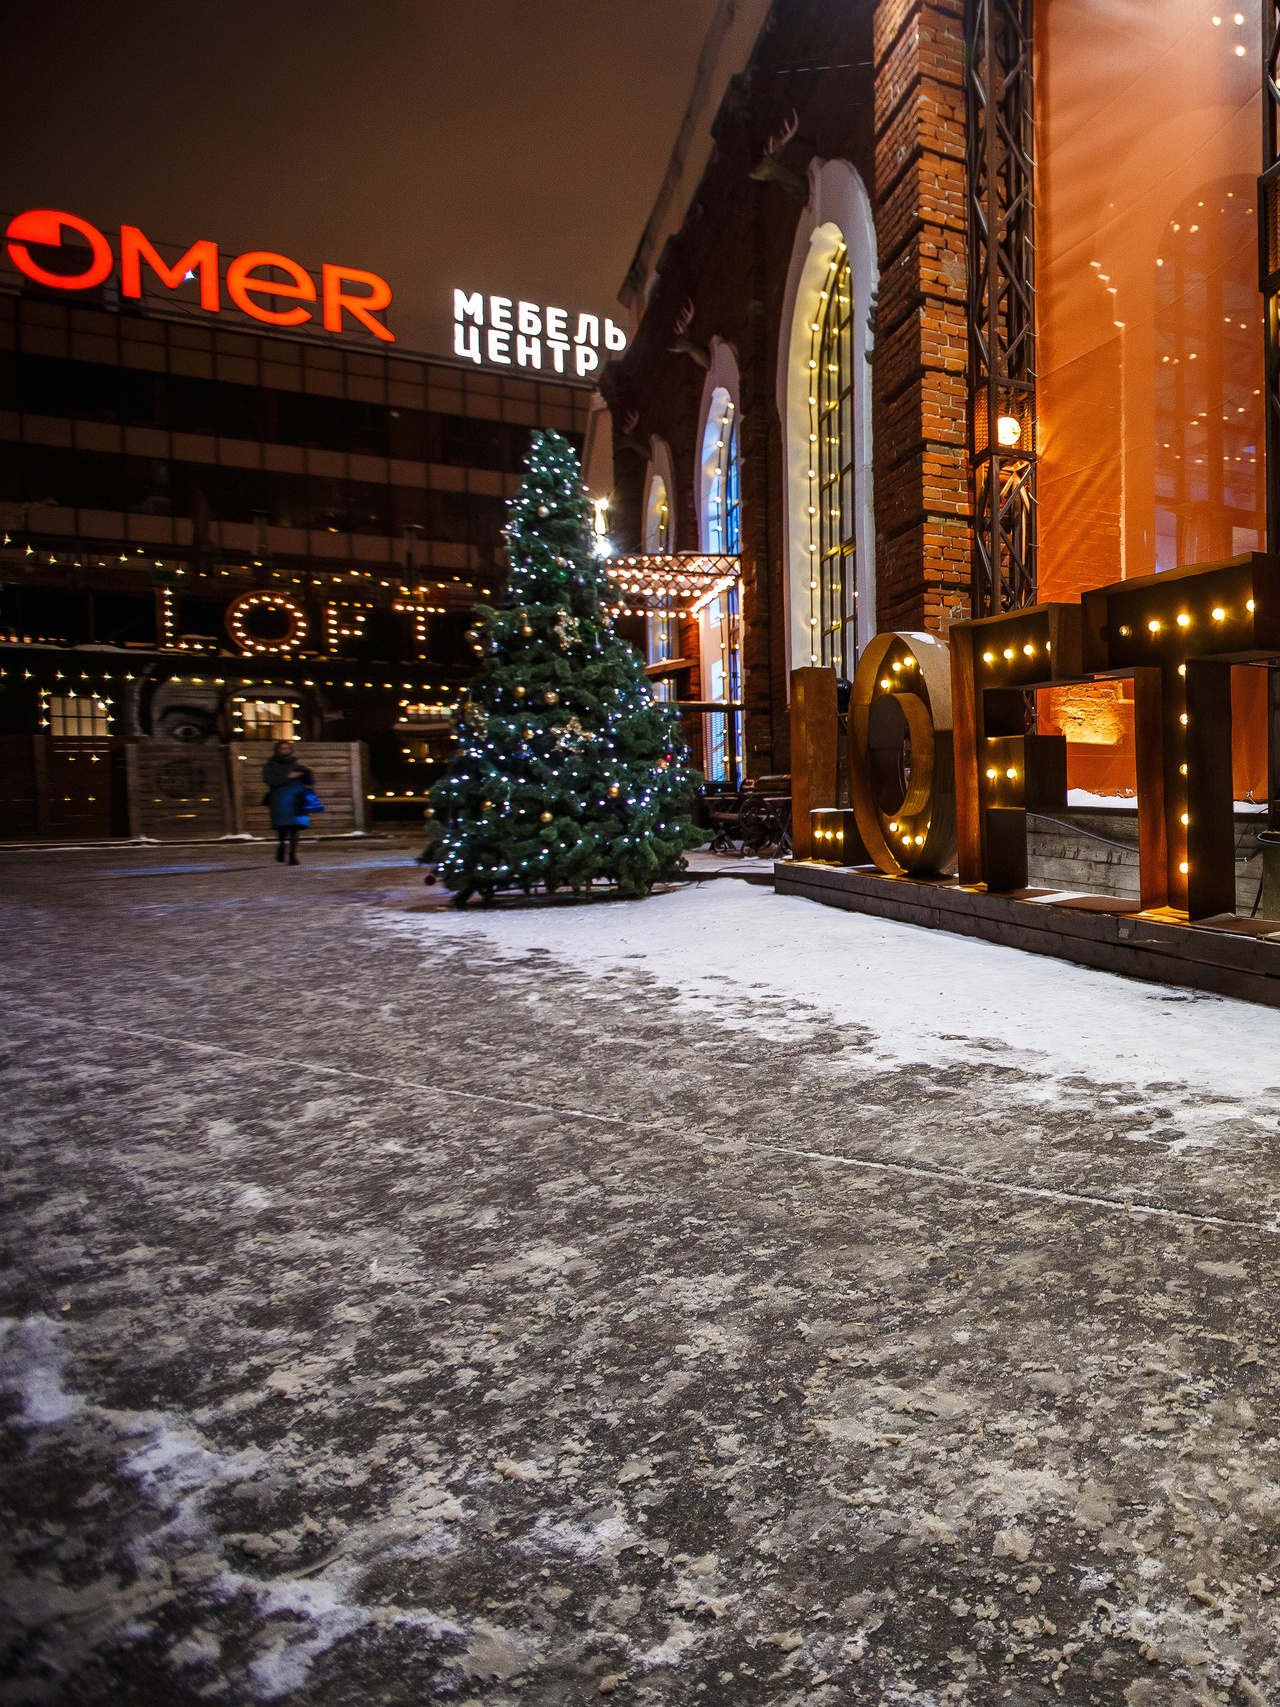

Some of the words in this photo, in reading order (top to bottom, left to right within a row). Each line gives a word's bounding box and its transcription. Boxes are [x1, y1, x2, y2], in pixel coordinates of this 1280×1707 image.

[453, 288, 627, 351] МЕБЕЛЬ
[453, 322, 599, 377] ЦЕНТР
[155, 585, 446, 659] LOFT
